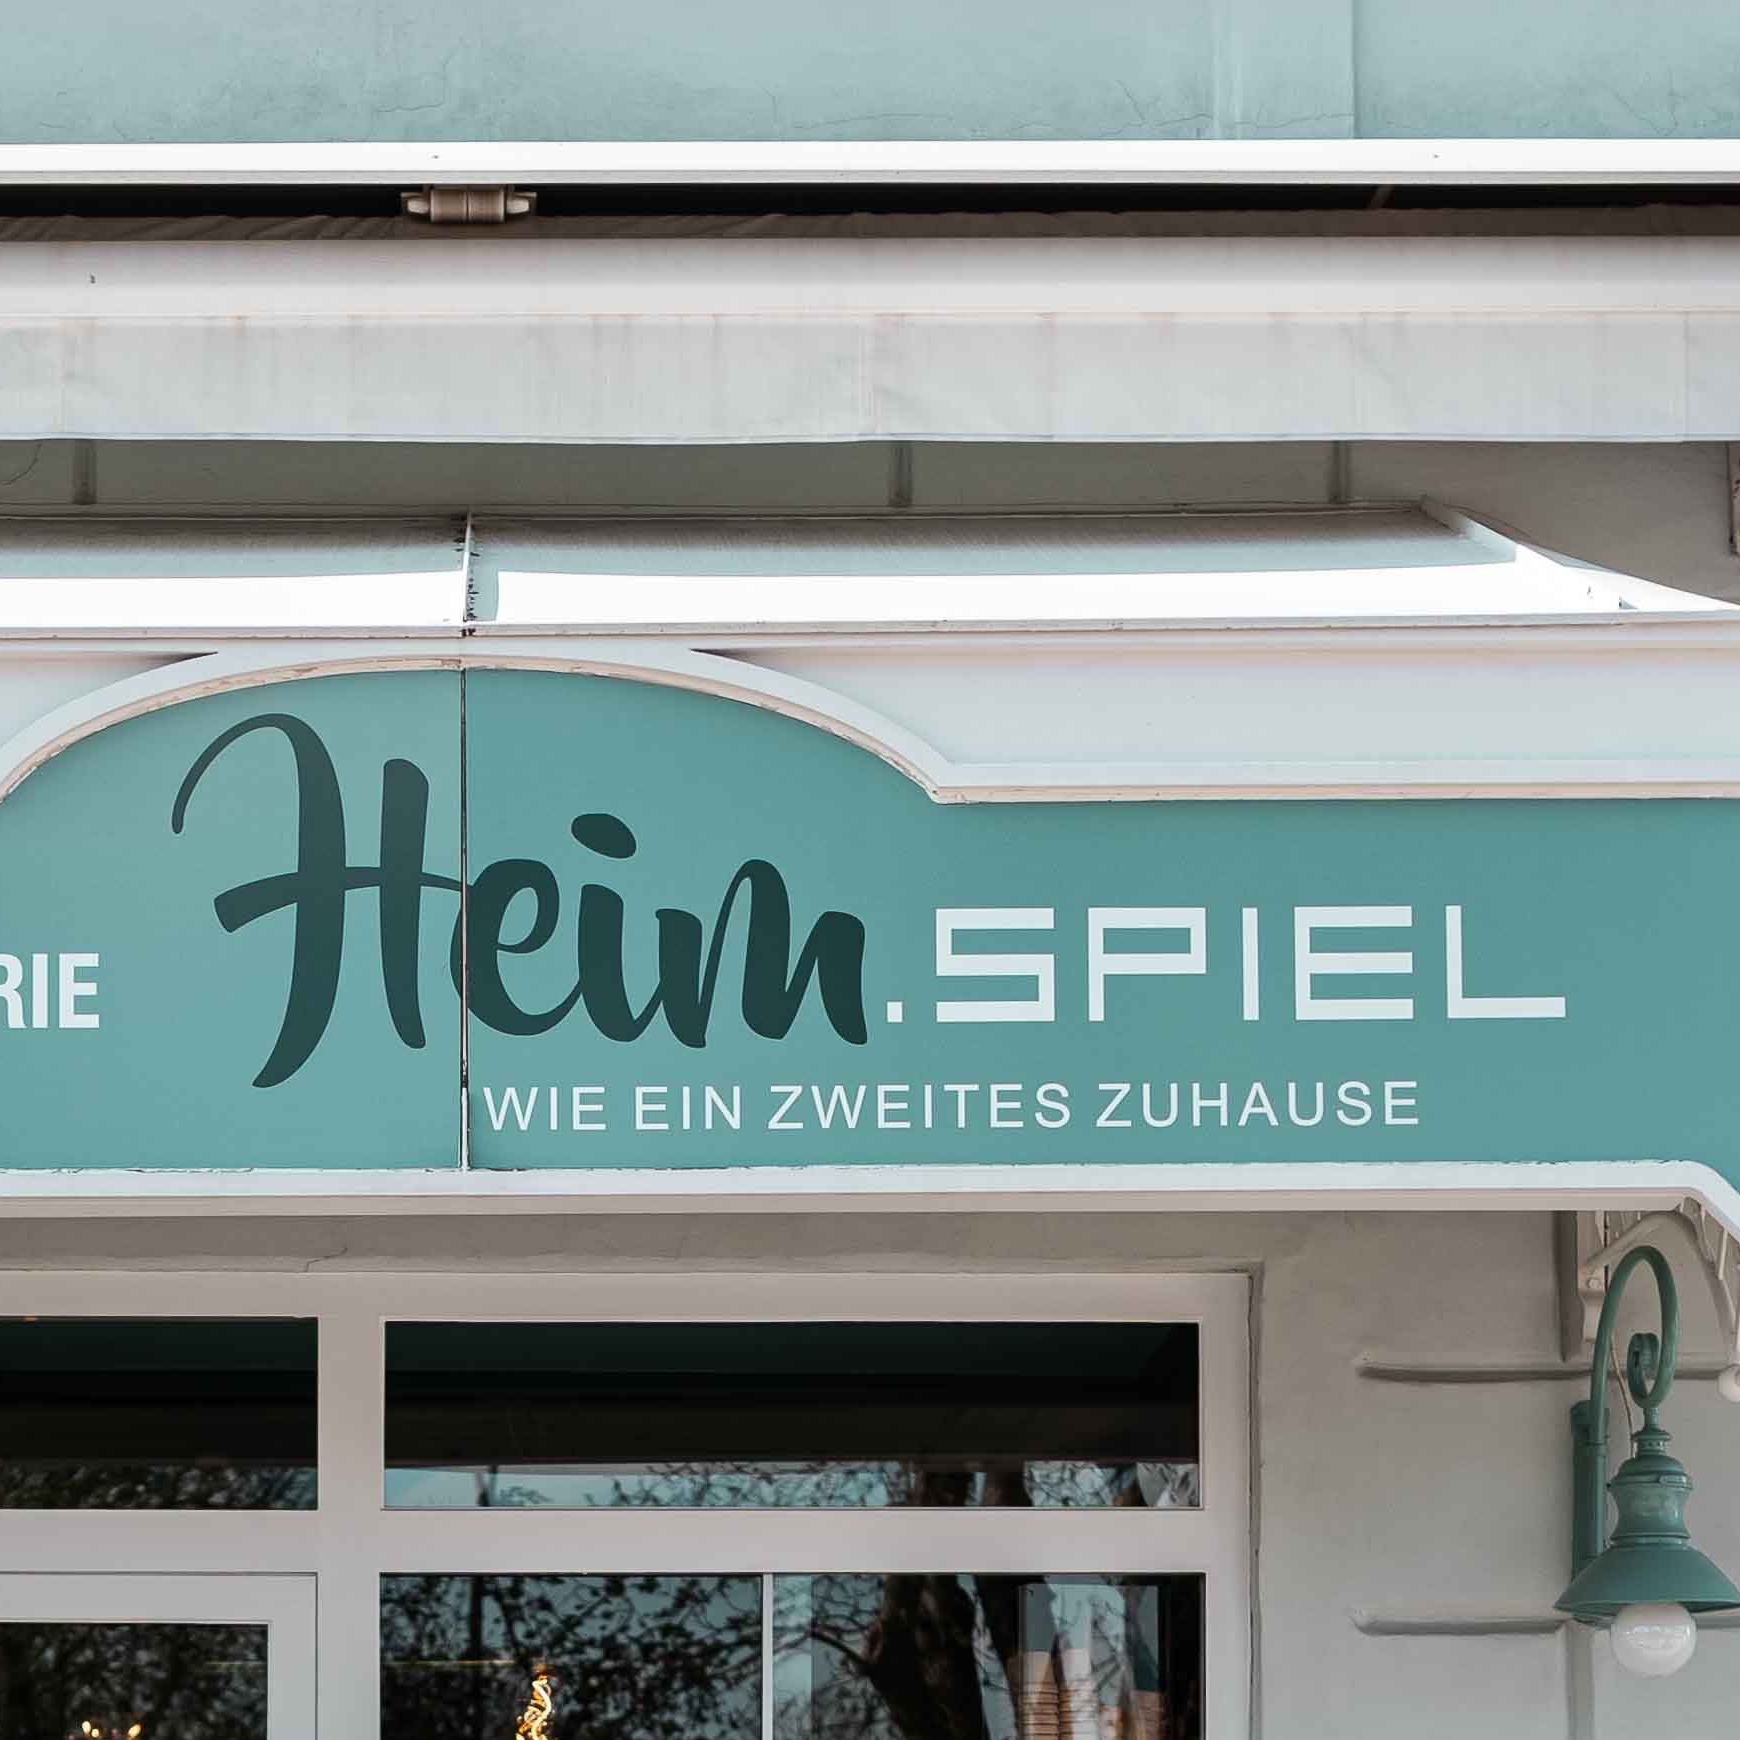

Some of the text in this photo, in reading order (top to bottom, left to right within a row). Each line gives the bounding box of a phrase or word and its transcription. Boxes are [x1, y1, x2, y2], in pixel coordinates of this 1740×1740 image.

[482, 1080, 1420, 1131] WIE EIN ZWEITES ZUHAUSE
